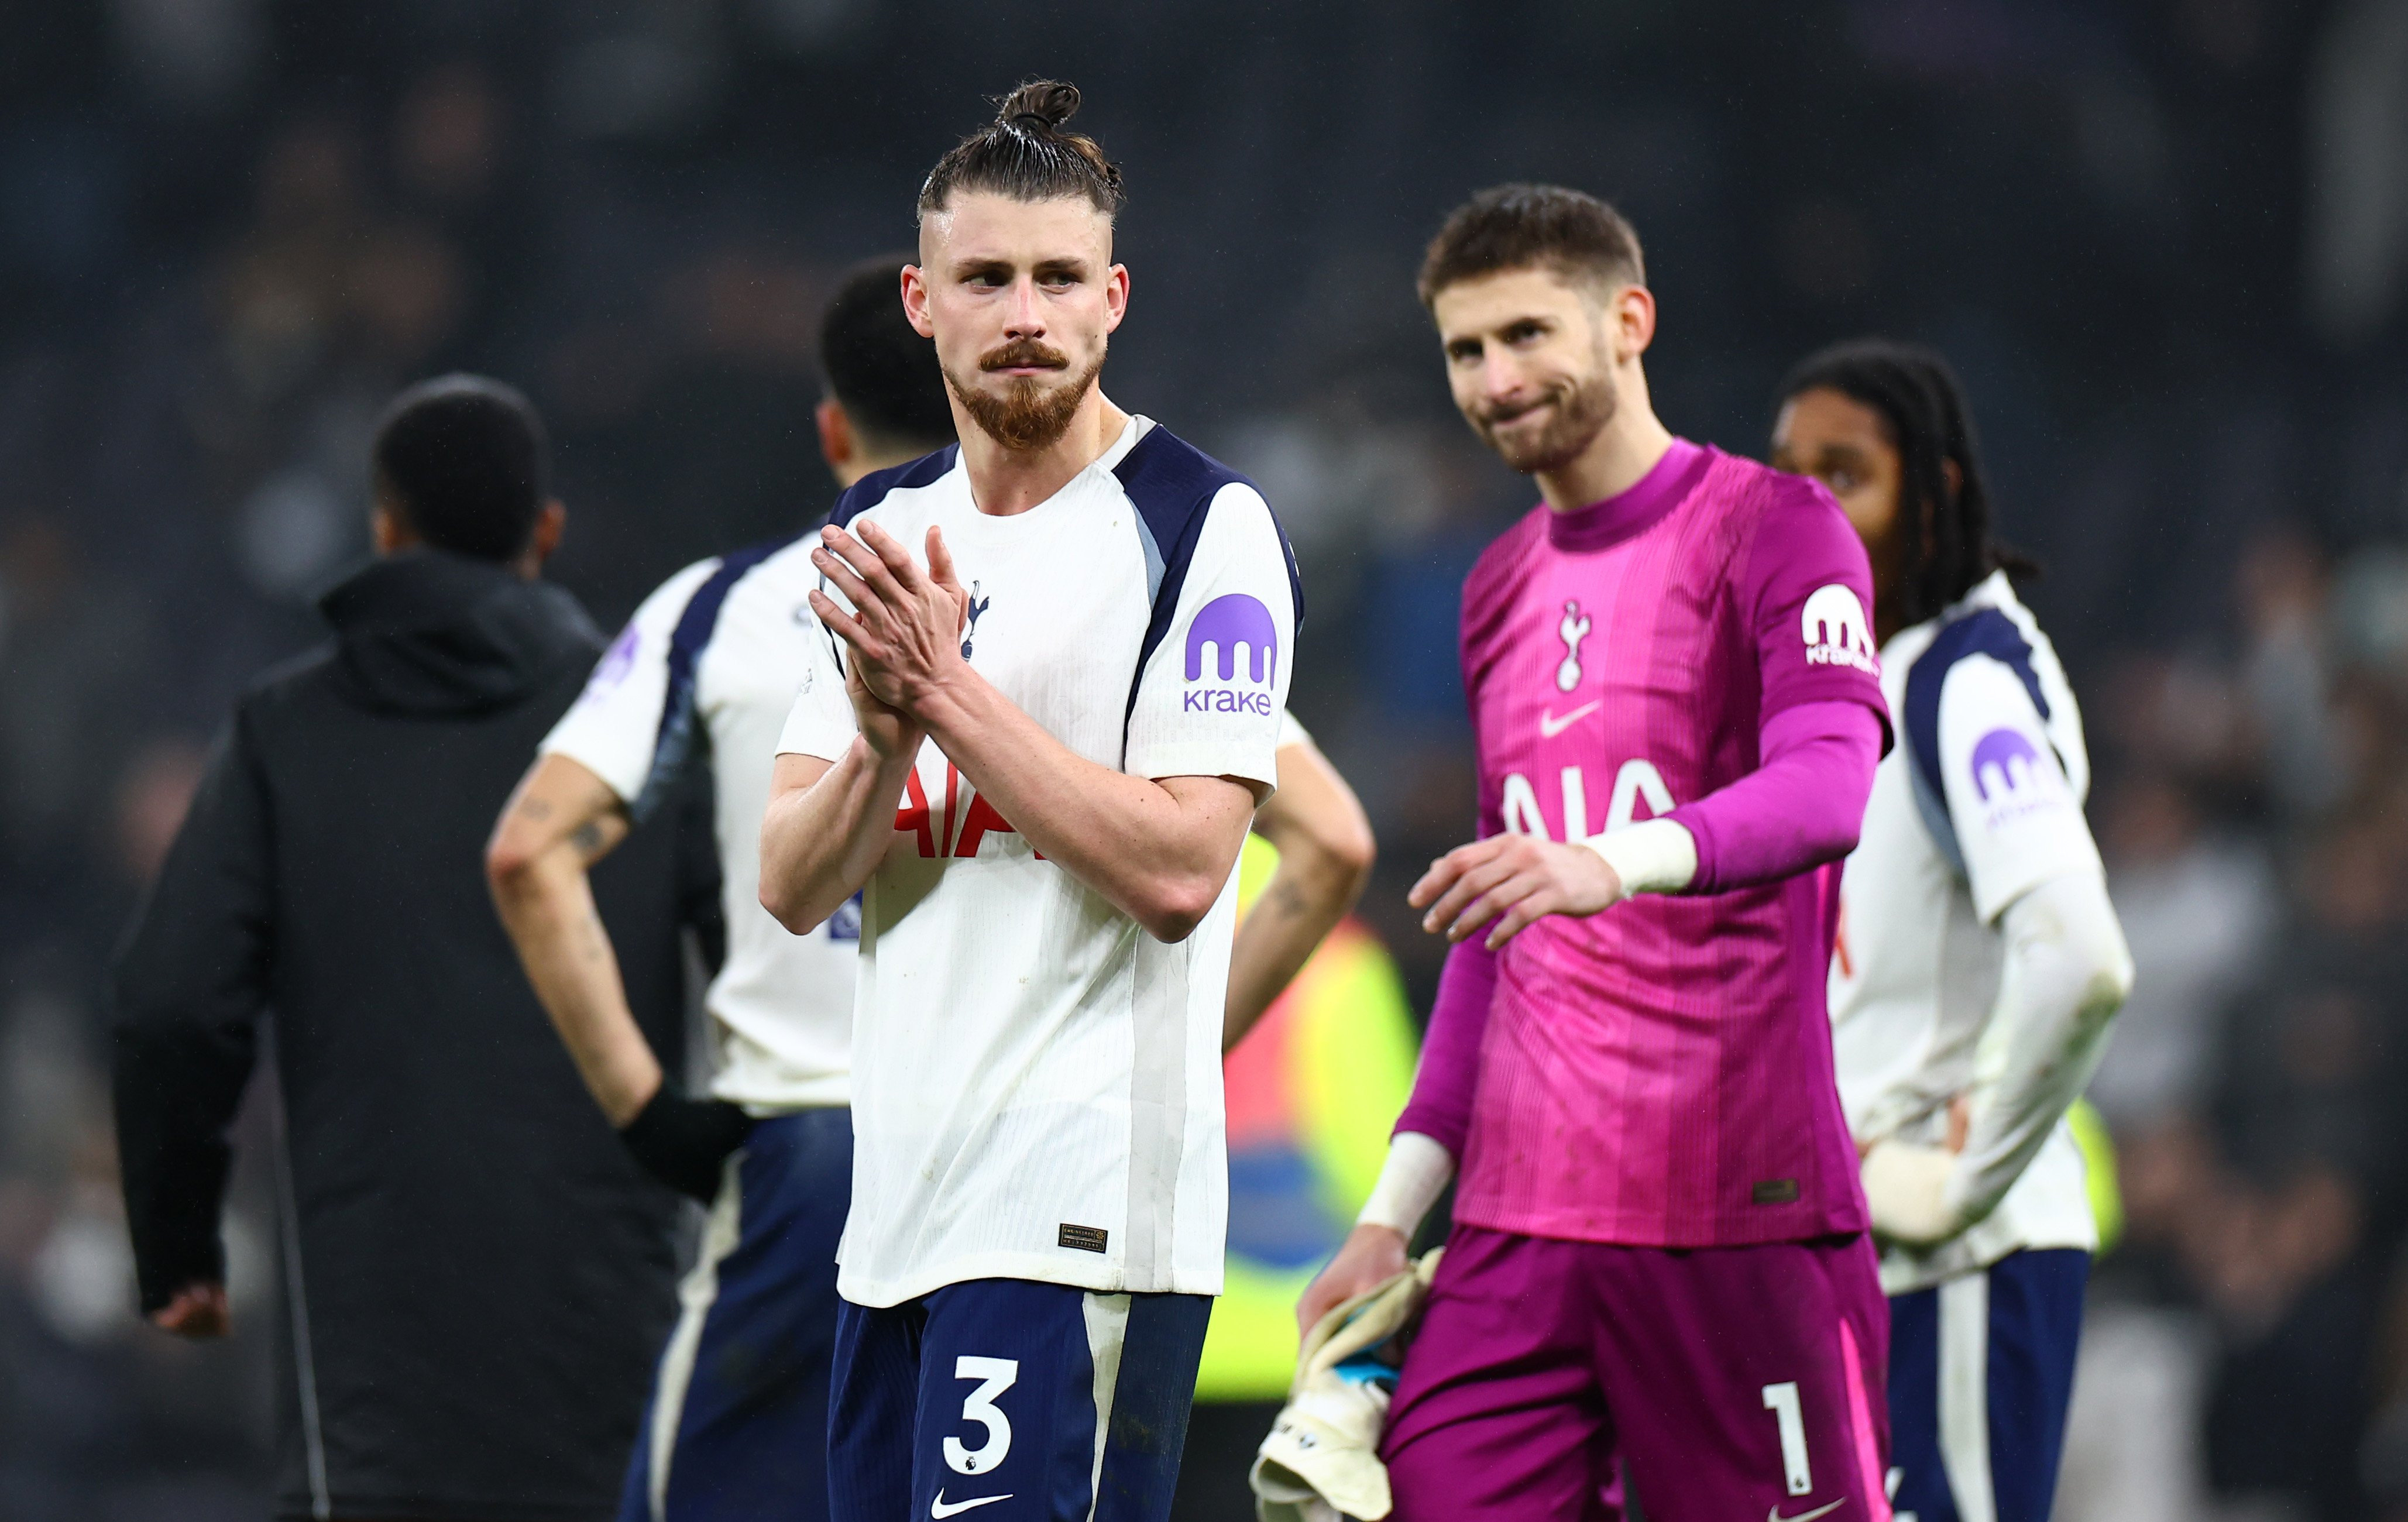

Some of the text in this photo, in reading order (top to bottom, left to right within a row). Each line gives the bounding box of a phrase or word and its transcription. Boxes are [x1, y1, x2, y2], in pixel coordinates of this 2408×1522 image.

[1503, 758, 1677, 844] AIA
[943, 1355, 1018, 1475] 3
[1761, 1380, 1813, 1497] 1
